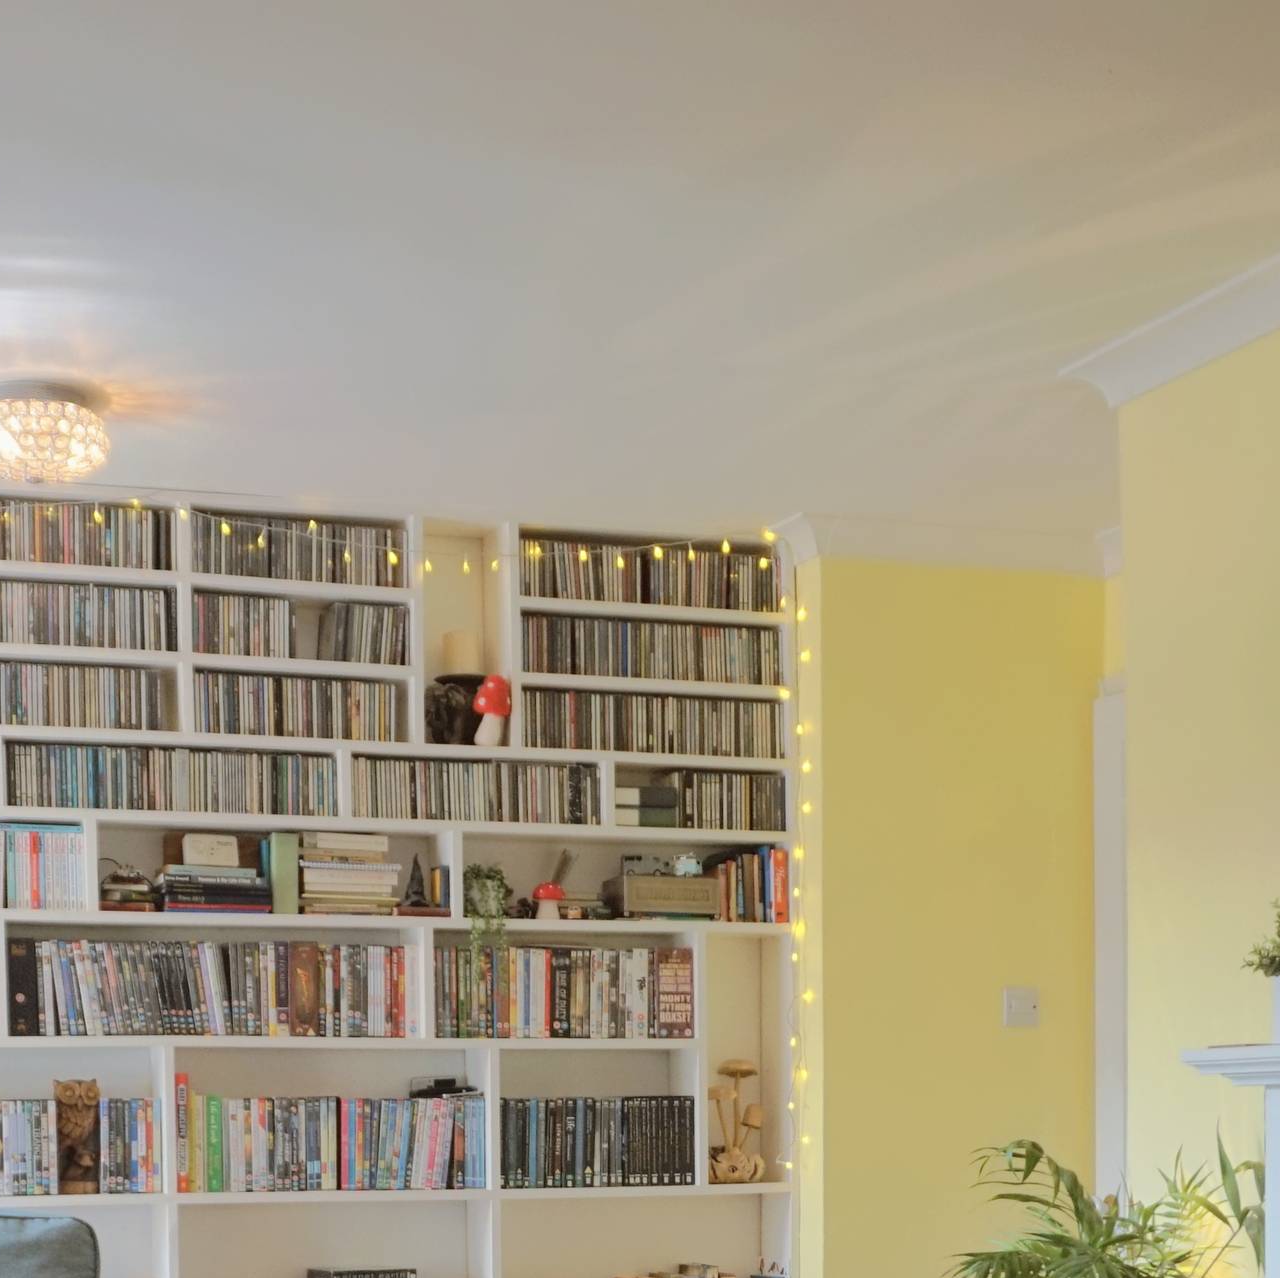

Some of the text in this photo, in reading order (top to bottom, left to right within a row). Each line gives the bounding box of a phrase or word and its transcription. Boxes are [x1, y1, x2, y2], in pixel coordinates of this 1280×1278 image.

[659, 994, 691, 1002] MONTY
[659, 1002, 691, 1011] PYTHON
[659, 1011, 691, 1023] BOXSET
[565, 1116, 576, 1131] Life
